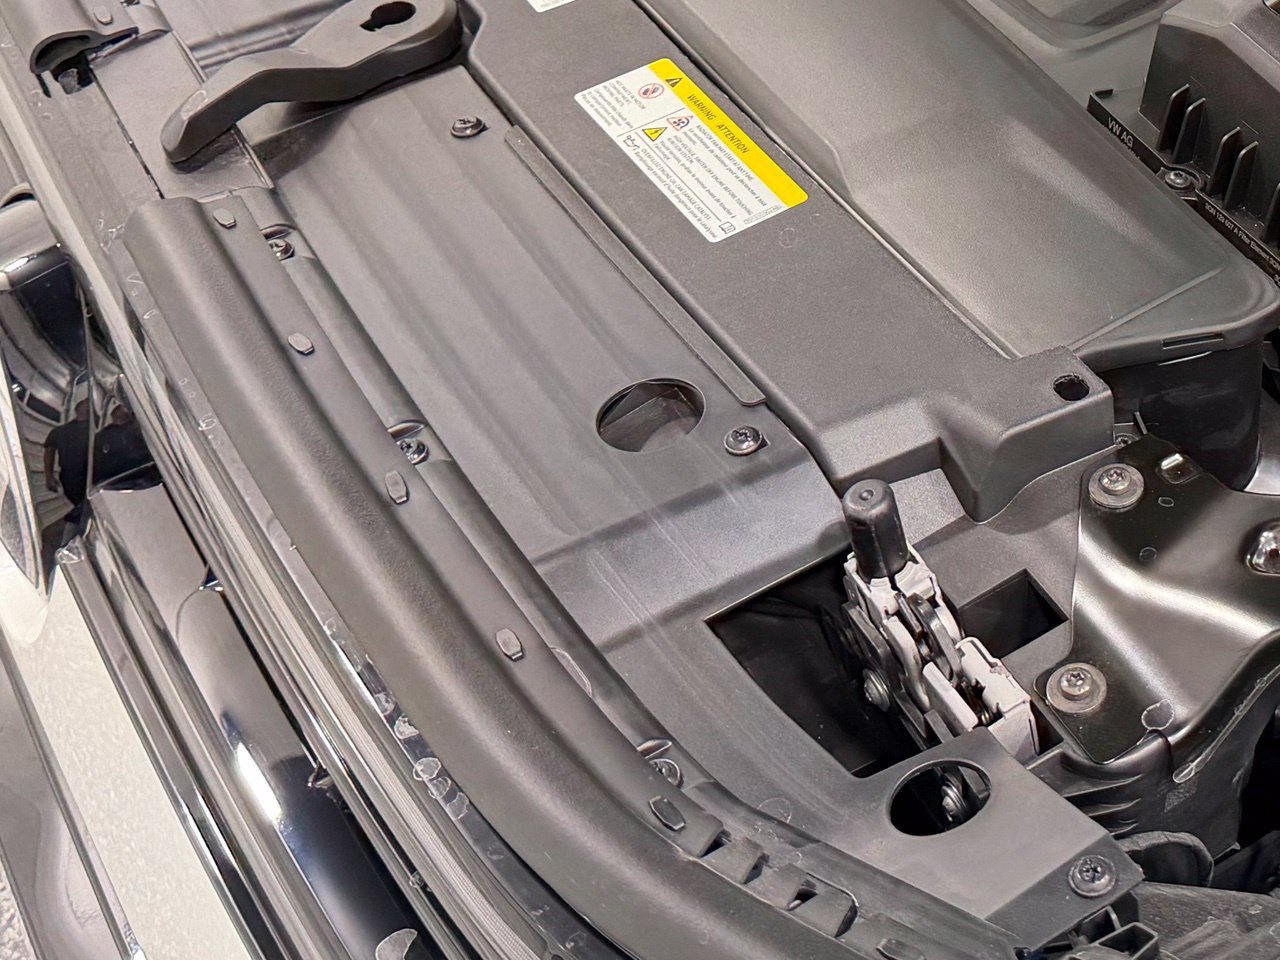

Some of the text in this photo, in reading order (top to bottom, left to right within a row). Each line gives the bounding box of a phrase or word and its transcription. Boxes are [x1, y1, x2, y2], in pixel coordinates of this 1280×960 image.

[687, 93, 749, 153] WARNING ATTENTION
[1108, 117, 1133, 147] VW AG
